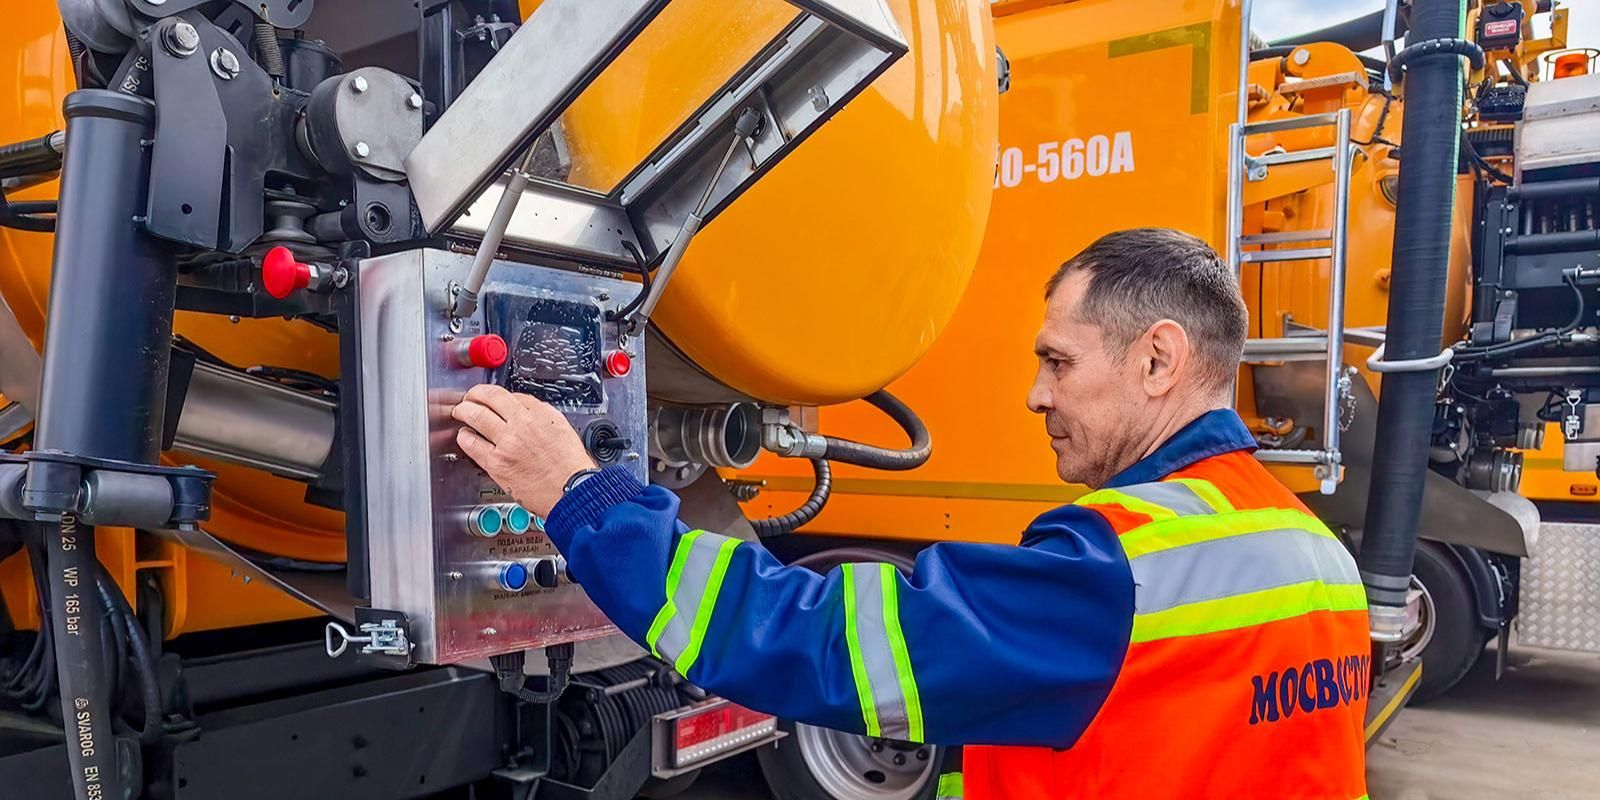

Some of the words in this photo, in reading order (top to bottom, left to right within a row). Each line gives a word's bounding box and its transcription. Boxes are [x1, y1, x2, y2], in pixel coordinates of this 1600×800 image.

[994, 131, 1135, 189] О-560А
[61, 515, 77, 533] DN
[62, 537, 77, 551] 25
[64, 567, 78, 587] WP
[65, 593, 80, 614] 165
[67, 615, 80, 636] bar
[1249, 654, 1371, 725] МОСВОСТО
[77, 711, 94, 757] SVAROG
[84, 765, 99, 782] EN
